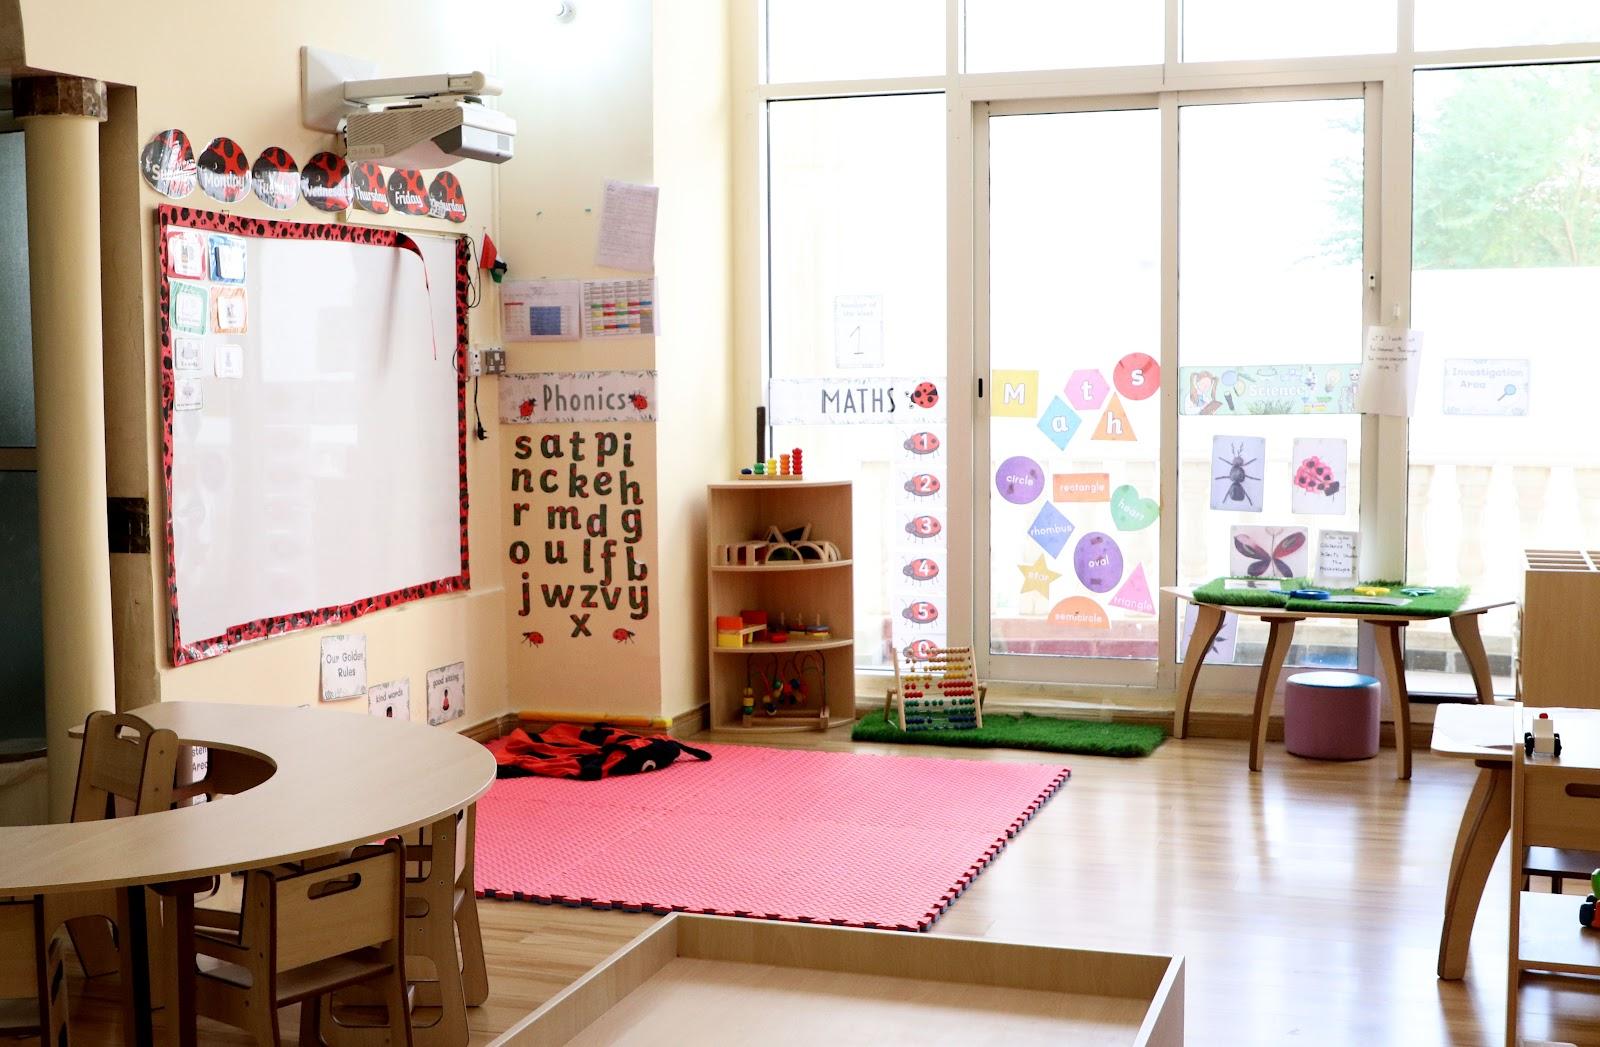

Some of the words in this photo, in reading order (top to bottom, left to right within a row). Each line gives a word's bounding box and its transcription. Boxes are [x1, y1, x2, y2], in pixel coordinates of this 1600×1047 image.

[204, 170, 245, 190] Monday
[355, 186, 388, 207] Thursday
[395, 191, 423, 208] Friday
[849, 325, 864, 355] 1
[1452, 367, 1523, 379] Investigation
[1249, 384, 1306, 398] Science
[1460, 380, 1487, 389] Area
[543, 384, 626, 411] Phonics
[821, 387, 896, 414] MATHS
[921, 433, 928, 450] 1
[920, 475, 931, 492] 2
[1006, 475, 1034, 487] circle
[1060, 481, 1105, 493] rectangle
[1118, 498, 1145, 521] heart
[921, 516, 932, 533] 3
[1030, 523, 1072, 536] rhombus
[918, 559, 929, 576] 4
[1088, 557, 1109, 568] oval
[918, 603, 929, 620] 5
[1113, 596, 1152, 611] triangle
[569, 613, 592, 638] x
[1055, 612, 1103, 624] semicircle
[326, 653, 339, 664] Our
[342, 650, 364, 663] Golden
[338, 667, 356, 677] Rules
[432, 675, 444, 688] good
[376, 692, 387, 702] kind
[388, 689, 403, 700] words
